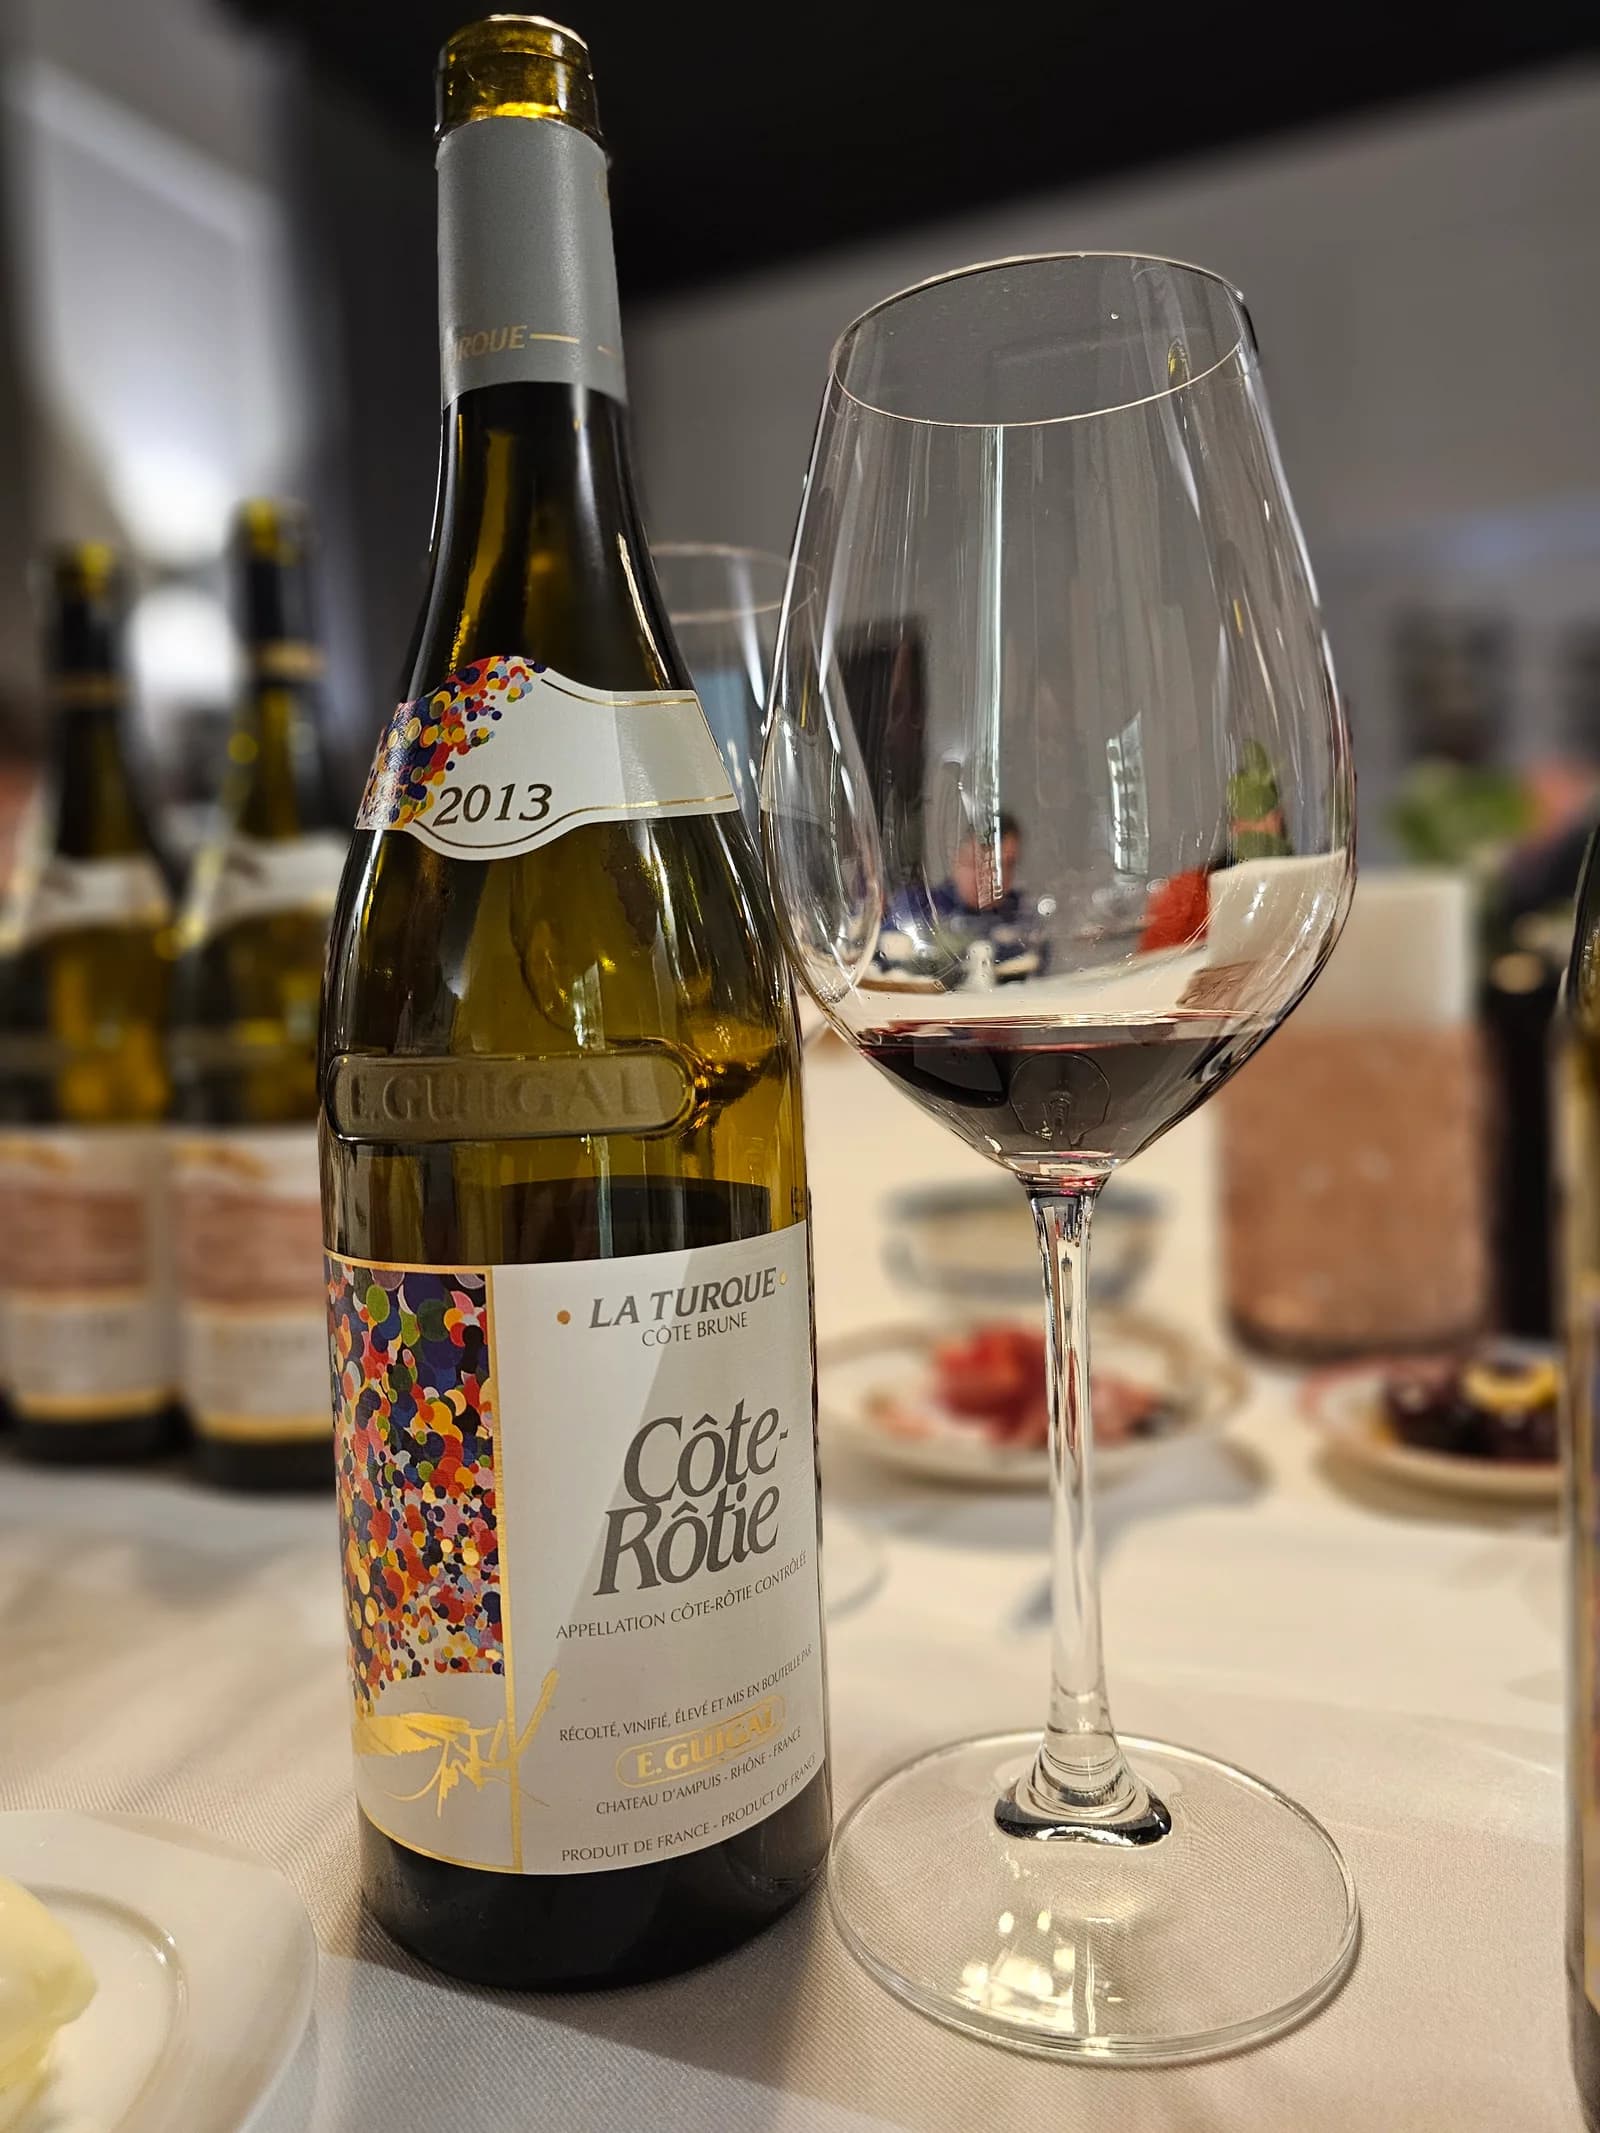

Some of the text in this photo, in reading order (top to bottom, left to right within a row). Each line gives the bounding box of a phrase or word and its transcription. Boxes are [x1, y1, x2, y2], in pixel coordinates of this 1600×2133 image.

[432, 782, 553, 827] 2013
[588, 1267, 777, 1329] LA TURQUE
[641, 1311, 749, 1347] CÔTE BRUNE
[623, 1398, 789, 1505] Côte-
[592, 1482, 780, 1596] Rôtie
[555, 1611, 665, 1639] APPELLATION
[670, 1583, 753, 1623] CÔTE-RÔTIE
[559, 1721, 621, 1742] RÉCOLTÉ,
[623, 1712, 671, 1736] VINIFIÉ,
[675, 1700, 709, 1724] ÉLEVÉ
[711, 1696, 724, 1713] ET
[726, 1689, 745, 1707] MIS
[747, 1682, 760, 1698] EN
[762, 1654, 801, 1691] BOUTEILLE
[596, 1793, 658, 1815] CHATEAU
[661, 1773, 721, 1803] D'AMPUIS
[730, 1752, 767, 1780] RHÔNE
[773, 1725, 801, 1757] FRANCE
[561, 1842, 629, 1862] PRODUIT
[633, 1838, 653, 1853] DE
[657, 1822, 710, 1848] FRANCE
[721, 1788, 775, 1827] PRODUCT
[776, 1779, 789, 1797] OF
